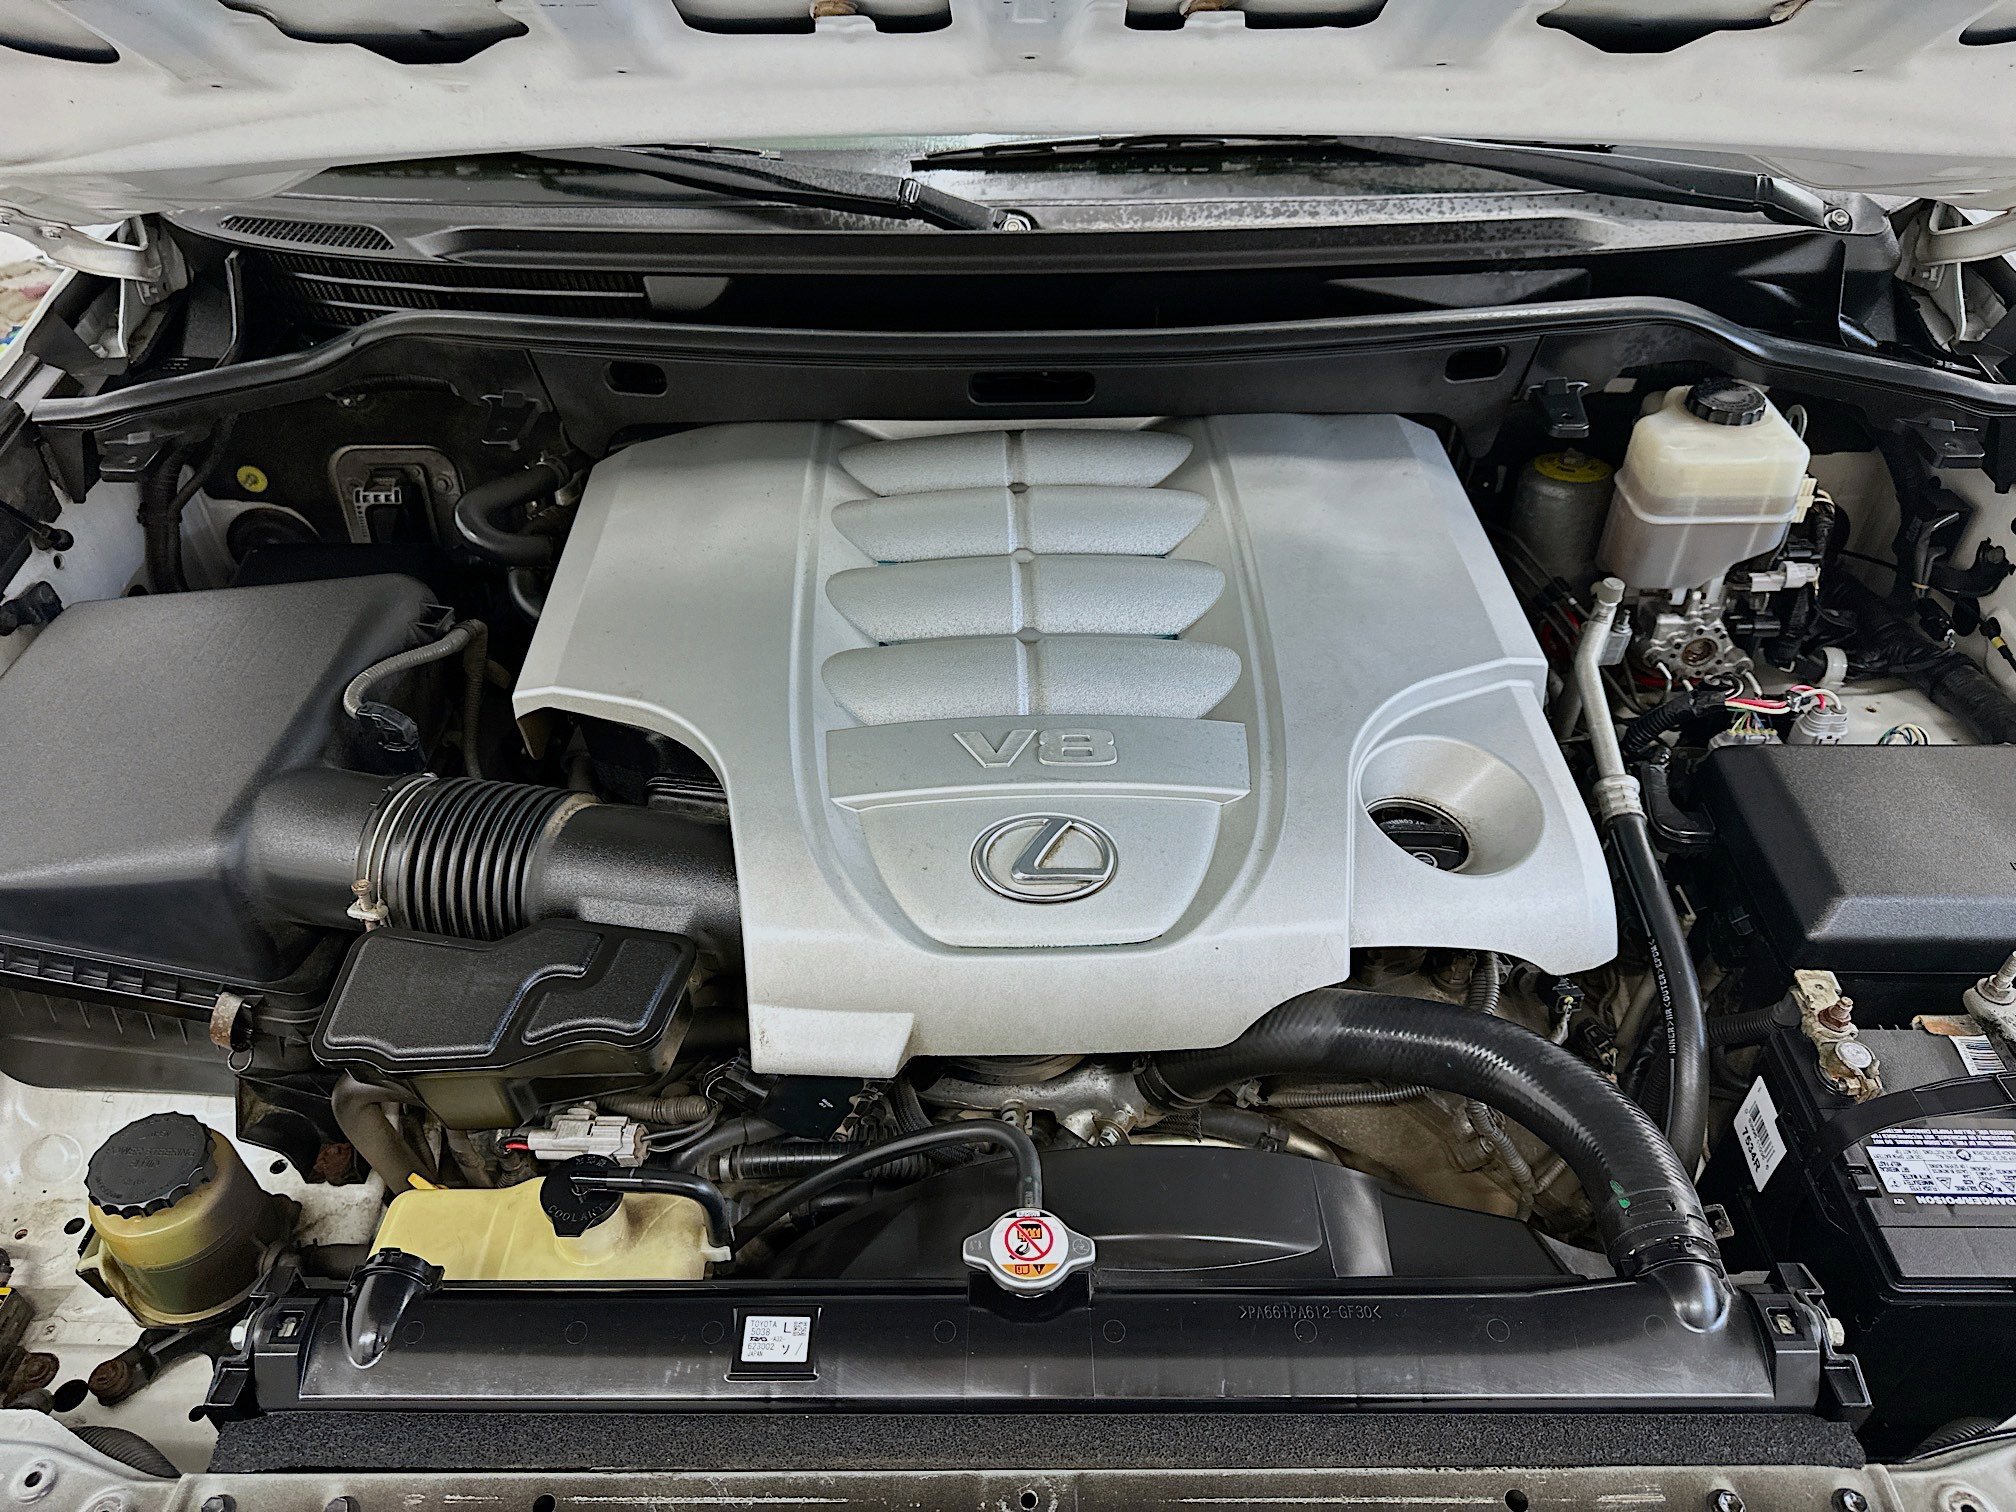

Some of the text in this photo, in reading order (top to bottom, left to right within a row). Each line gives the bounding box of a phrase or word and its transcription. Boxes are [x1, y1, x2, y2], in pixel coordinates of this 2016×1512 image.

[953, 729, 1118, 768] V8
[547, 1204, 605, 1222] COOLANT
[751, 1320, 777, 1328] TOYOTA
[751, 1327, 771, 1336] 5038
